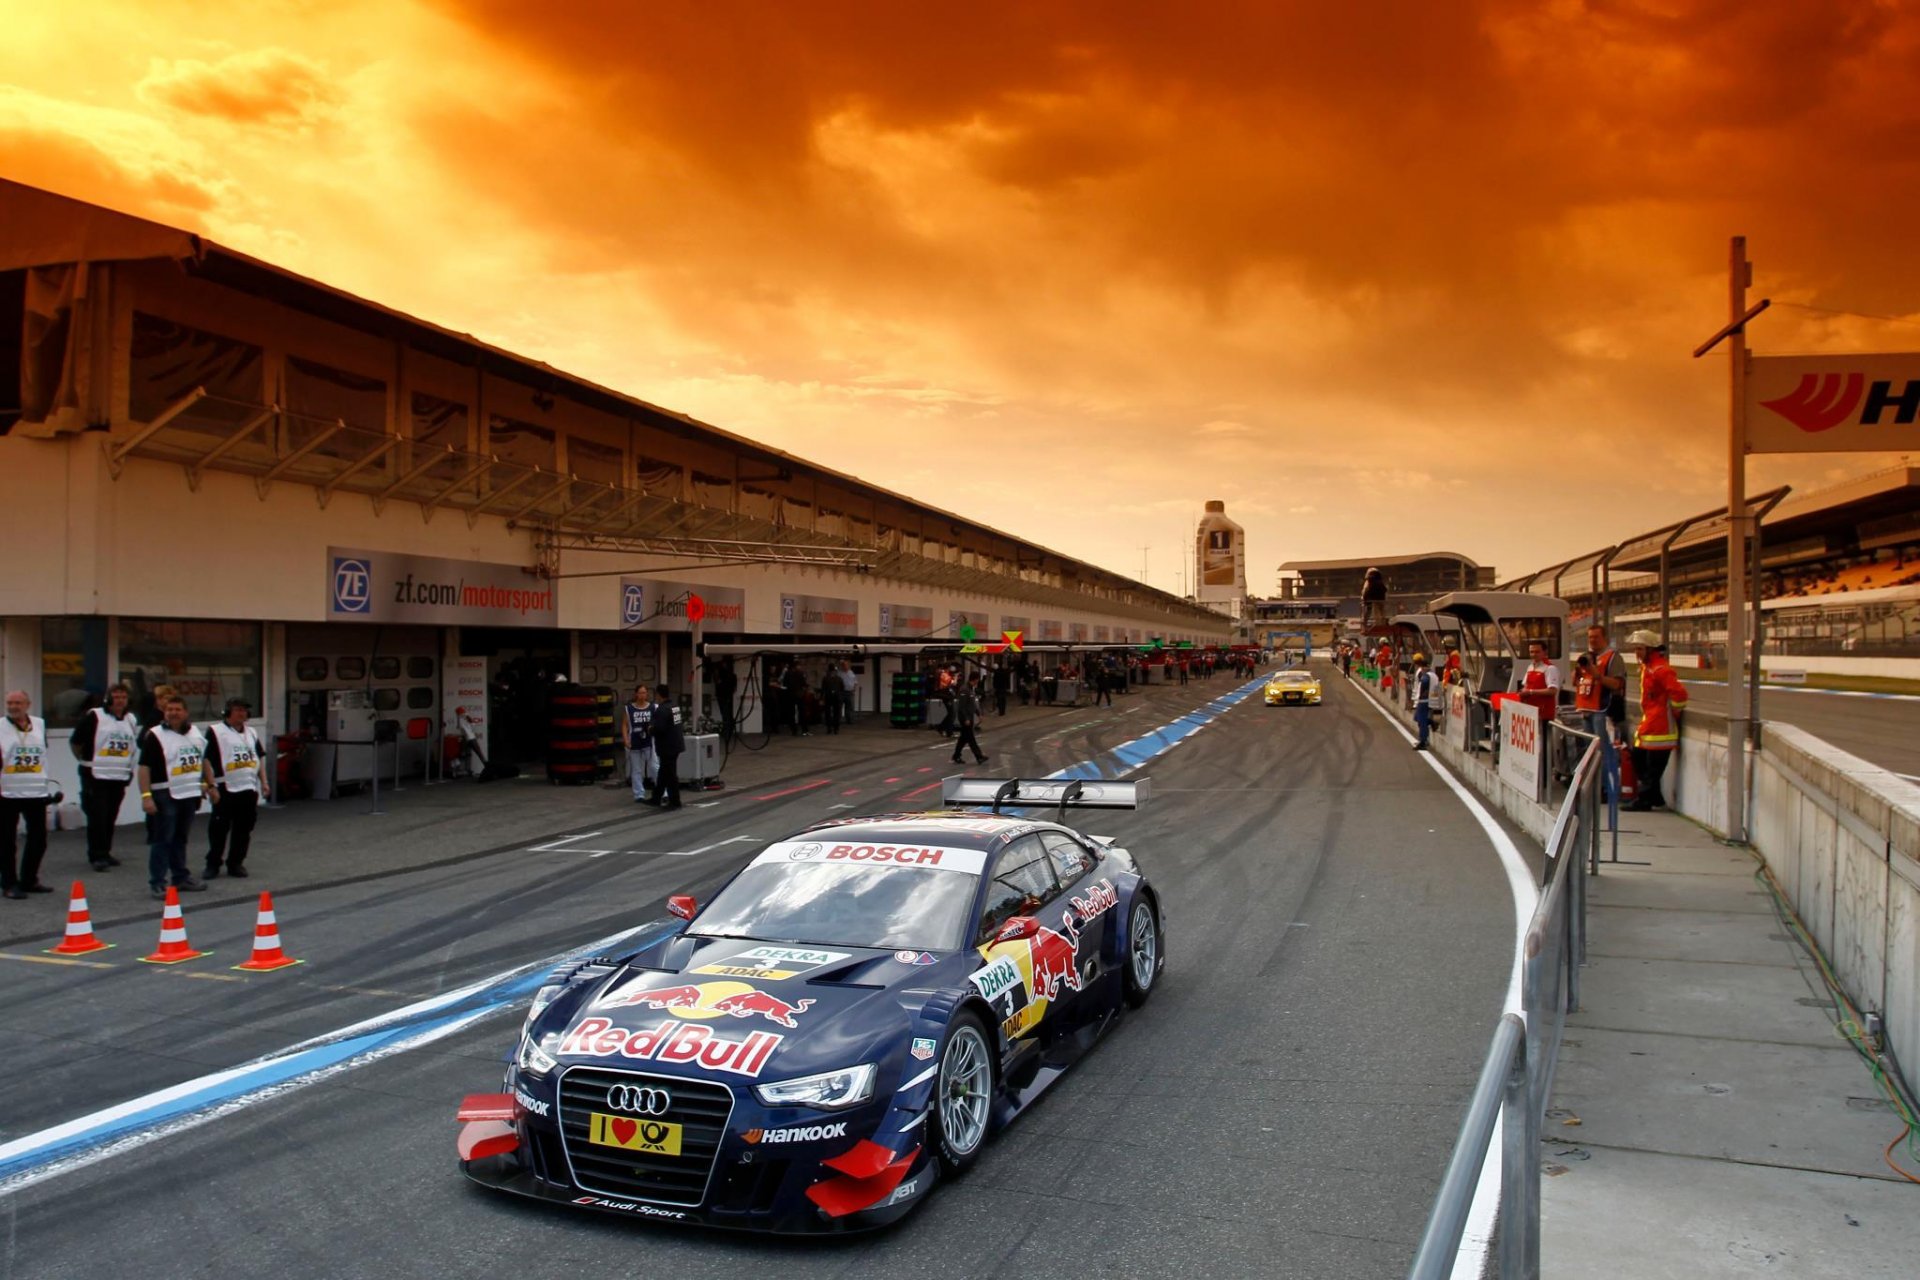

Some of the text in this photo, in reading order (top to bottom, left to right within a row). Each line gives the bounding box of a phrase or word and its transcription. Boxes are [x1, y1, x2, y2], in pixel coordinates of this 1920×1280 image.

[1860, 380, 1920, 424] H
[339, 569, 368, 600] ZF
[395, 573, 553, 615] zf.com/motorsport
[1511, 713, 1535, 755] BOSCH
[15, 756, 39, 765] 295
[826, 845, 944, 865] BOSCH
[753, 948, 830, 963] DEKRA
[754, 958, 777, 970] 3
[718, 965, 774, 978] ADAC
[979, 961, 1016, 998] DEKRA
[1004, 991, 1015, 1016] 3
[888, 1180, 917, 1205] ABT
[595, 1199, 686, 1219] Audi Sport
